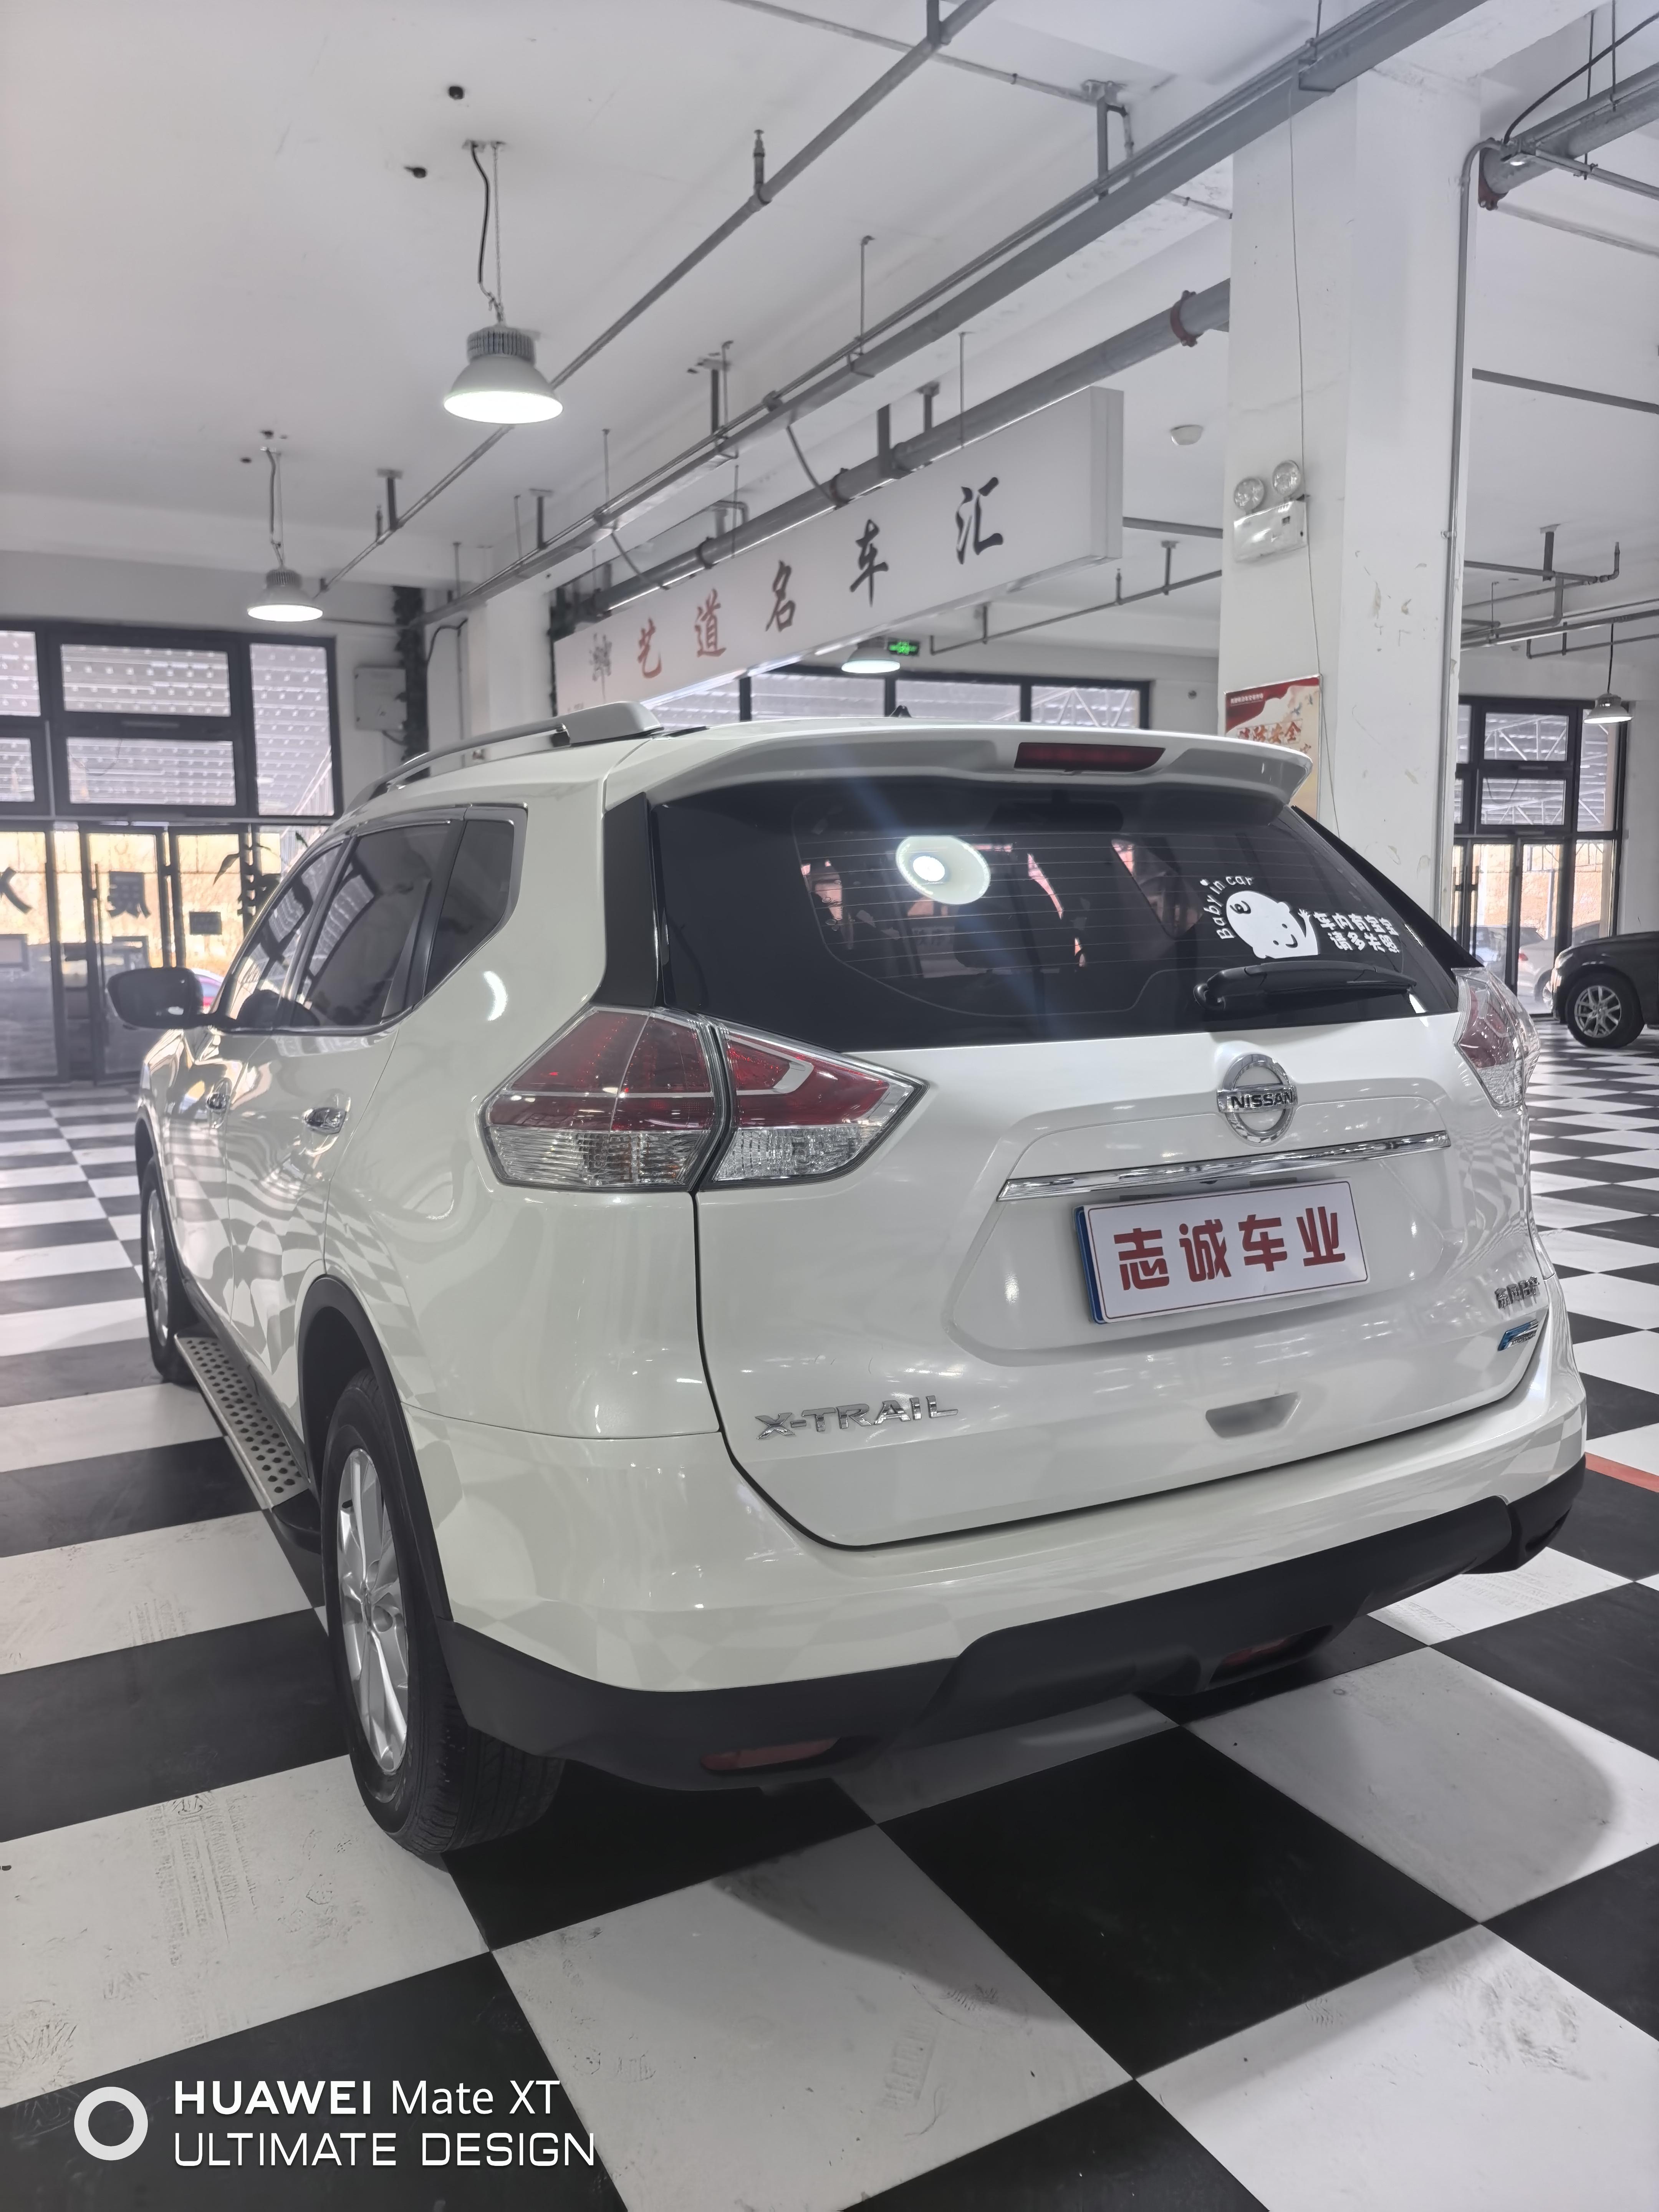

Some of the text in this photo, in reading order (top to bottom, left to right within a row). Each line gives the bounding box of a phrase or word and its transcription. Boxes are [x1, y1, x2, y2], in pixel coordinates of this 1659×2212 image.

[1200, 876, 1253, 939] Baby in car
[1313, 912, 1399, 936] 车内有宝宝
[1328, 931, 1400, 954] 请多关照
[1230, 1091, 1293, 1108] NISSAN
[1113, 1206, 1346, 1291] 志诚车业
[754, 1395, 959, 1440] X-TRAIL
